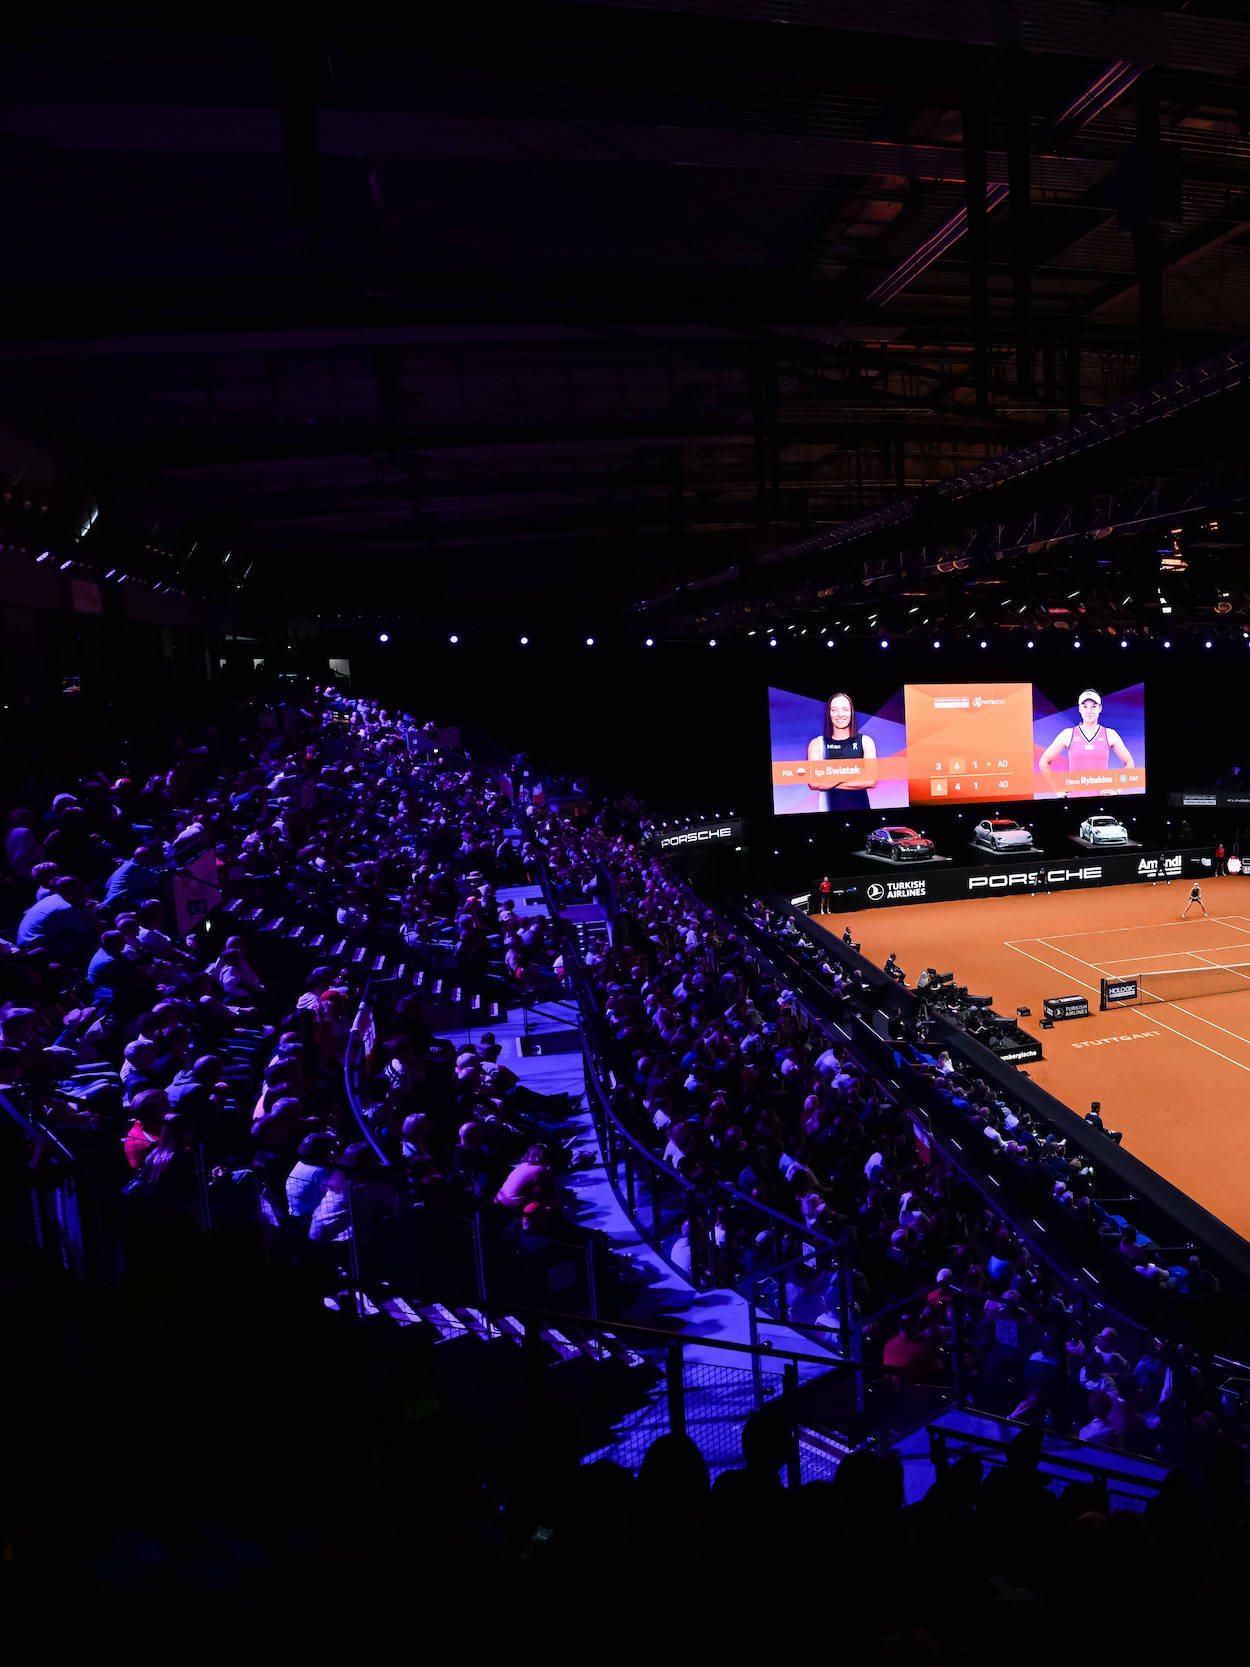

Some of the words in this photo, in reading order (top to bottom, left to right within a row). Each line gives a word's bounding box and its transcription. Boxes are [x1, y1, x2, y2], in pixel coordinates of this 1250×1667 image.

[826, 765, 860, 776] Swiatek
[936, 762, 942, 771] 3
[954, 761, 960, 770] 6
[973, 761, 978, 769] 1
[998, 760, 1008, 768] AD
[936, 783, 942, 792] 6
[954, 783, 961, 791] 4
[973, 782, 979, 790] 1
[998, 780, 1009, 789] 40
[661, 827, 732, 849] PORSCHE
[1138, 855, 1182, 870] Amndi
[887, 880, 926, 890] TURKISH
[887, 888, 926, 899] AIRLINES
[1108, 984, 1136, 995] HOLOGIC
[1072, 1031, 1161, 1049] STUTTGART
